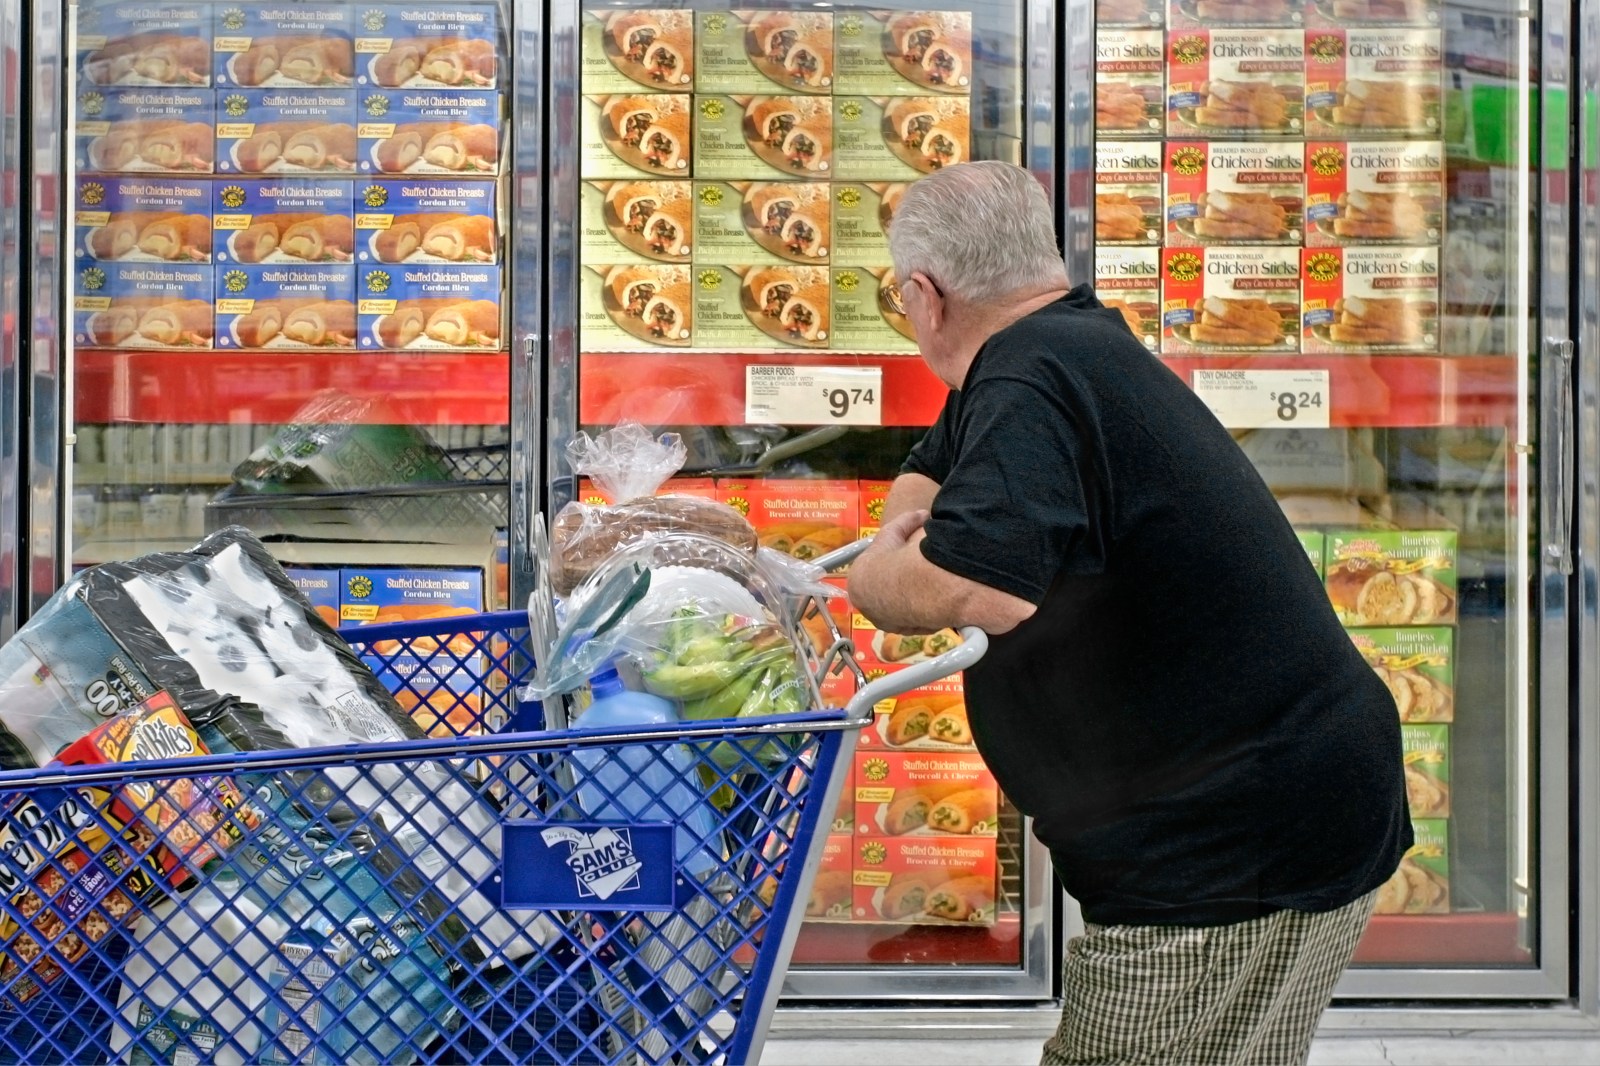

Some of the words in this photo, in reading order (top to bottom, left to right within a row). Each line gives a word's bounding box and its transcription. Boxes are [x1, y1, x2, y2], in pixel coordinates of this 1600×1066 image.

[260, 10, 286, 20] Stuffed
[287, 10, 314, 20] Chicken
[317, 11, 343, 20] Breasts
[401, 11, 426, 21] Stuffed
[427, 11, 455, 21] Chicken
[457, 12, 483, 21] Breasts
[1172, 35, 1207, 49] BARBER
[1123, 44, 1160, 58] Sticks
[1213, 44, 1263, 57] Chicken
[1267, 44, 1302, 57] Sticks
[1175, 55, 1204, 64] FOODS
[263, 96, 288, 105] Stuffed
[289, 96, 317, 105] Chicken
[319, 97, 345, 106] Breasts
[404, 97, 429, 106] Stuffed
[430, 97, 458, 106] Chicken
[460, 97, 486, 106] Breasts
[1171, 147, 1205, 160] BARBER
[1310, 147, 1345, 160] BARBER
[1122, 155, 1158, 168] Sticks
[1212, 155, 1262, 169] Chicken
[1265, 156, 1301, 169] Sticks
[1350, 155, 1400, 169] Chicken
[1403, 156, 1439, 169] Sticks
[1174, 166, 1203, 175] FOODS
[1313, 166, 1342, 175] FOODS
[119, 186, 144, 195] Stuffed
[145, 186, 173, 195] Chicken
[175, 186, 201, 196] Breasts
[260, 187, 285, 197] Stuffed
[286, 187, 314, 197] Chicken
[316, 188, 342, 197] Breasts
[402, 187, 427, 197] Stuffed
[428, 187, 456, 197] Chicken
[458, 188, 484, 197] Breasts
[1167, 253, 1202, 266] BARBER
[1306, 253, 1341, 266] BARBER
[1120, 261, 1156, 274] Sticks
[1208, 261, 1258, 275] Chicken
[1261, 262, 1297, 275] Sticks
[1347, 260, 1397, 274] Chicken
[1400, 261, 1436, 274] Sticks
[119, 271, 145, 280] Stuffed
[146, 271, 173, 280] Chicken
[176, 272, 202, 281] Breasts
[262, 272, 288, 281] Stuffed
[289, 272, 316, 281] Chicken
[319, 273, 345, 282] Breasts
[405, 272, 430, 282] Stuffed
[432, 272, 459, 282] Chicken
[461, 273, 487, 282] Breasts
[1170, 272, 1199, 281] FOODS
[1309, 272, 1338, 281] FOODS
[752, 367, 774, 375] BARBER
[764, 499, 788, 509] Stuffed
[790, 499, 818, 509] Chicken
[820, 500, 847, 509] Breasts
[1402, 535, 1440, 546] Boneless
[1423, 547, 1453, 558] Chicken
[301, 579, 327, 588] Breasts
[387, 578, 411, 588] Stuffed
[413, 578, 440, 588] Chicken
[443, 579, 469, 589] Breasts
[1396, 632, 1435, 642] Boneless
[1415, 643, 1449, 654] Chicken
[111, 657, 126, 674] Roll
[125, 671, 136, 686] Per
[135, 681, 149, 700] eets
[1411, 740, 1445, 751] Chicken
[903, 760, 928, 770] Stuffed
[930, 760, 957, 770] Chicken
[960, 761, 986, 770] Breasts
[901, 846, 926, 856] Stuffed
[928, 846, 955, 856] Chicken
[570, 840, 630, 874] SAM'S
[583, 856, 636, 882] CLUB
[147, 1029, 166, 1040] 2%
